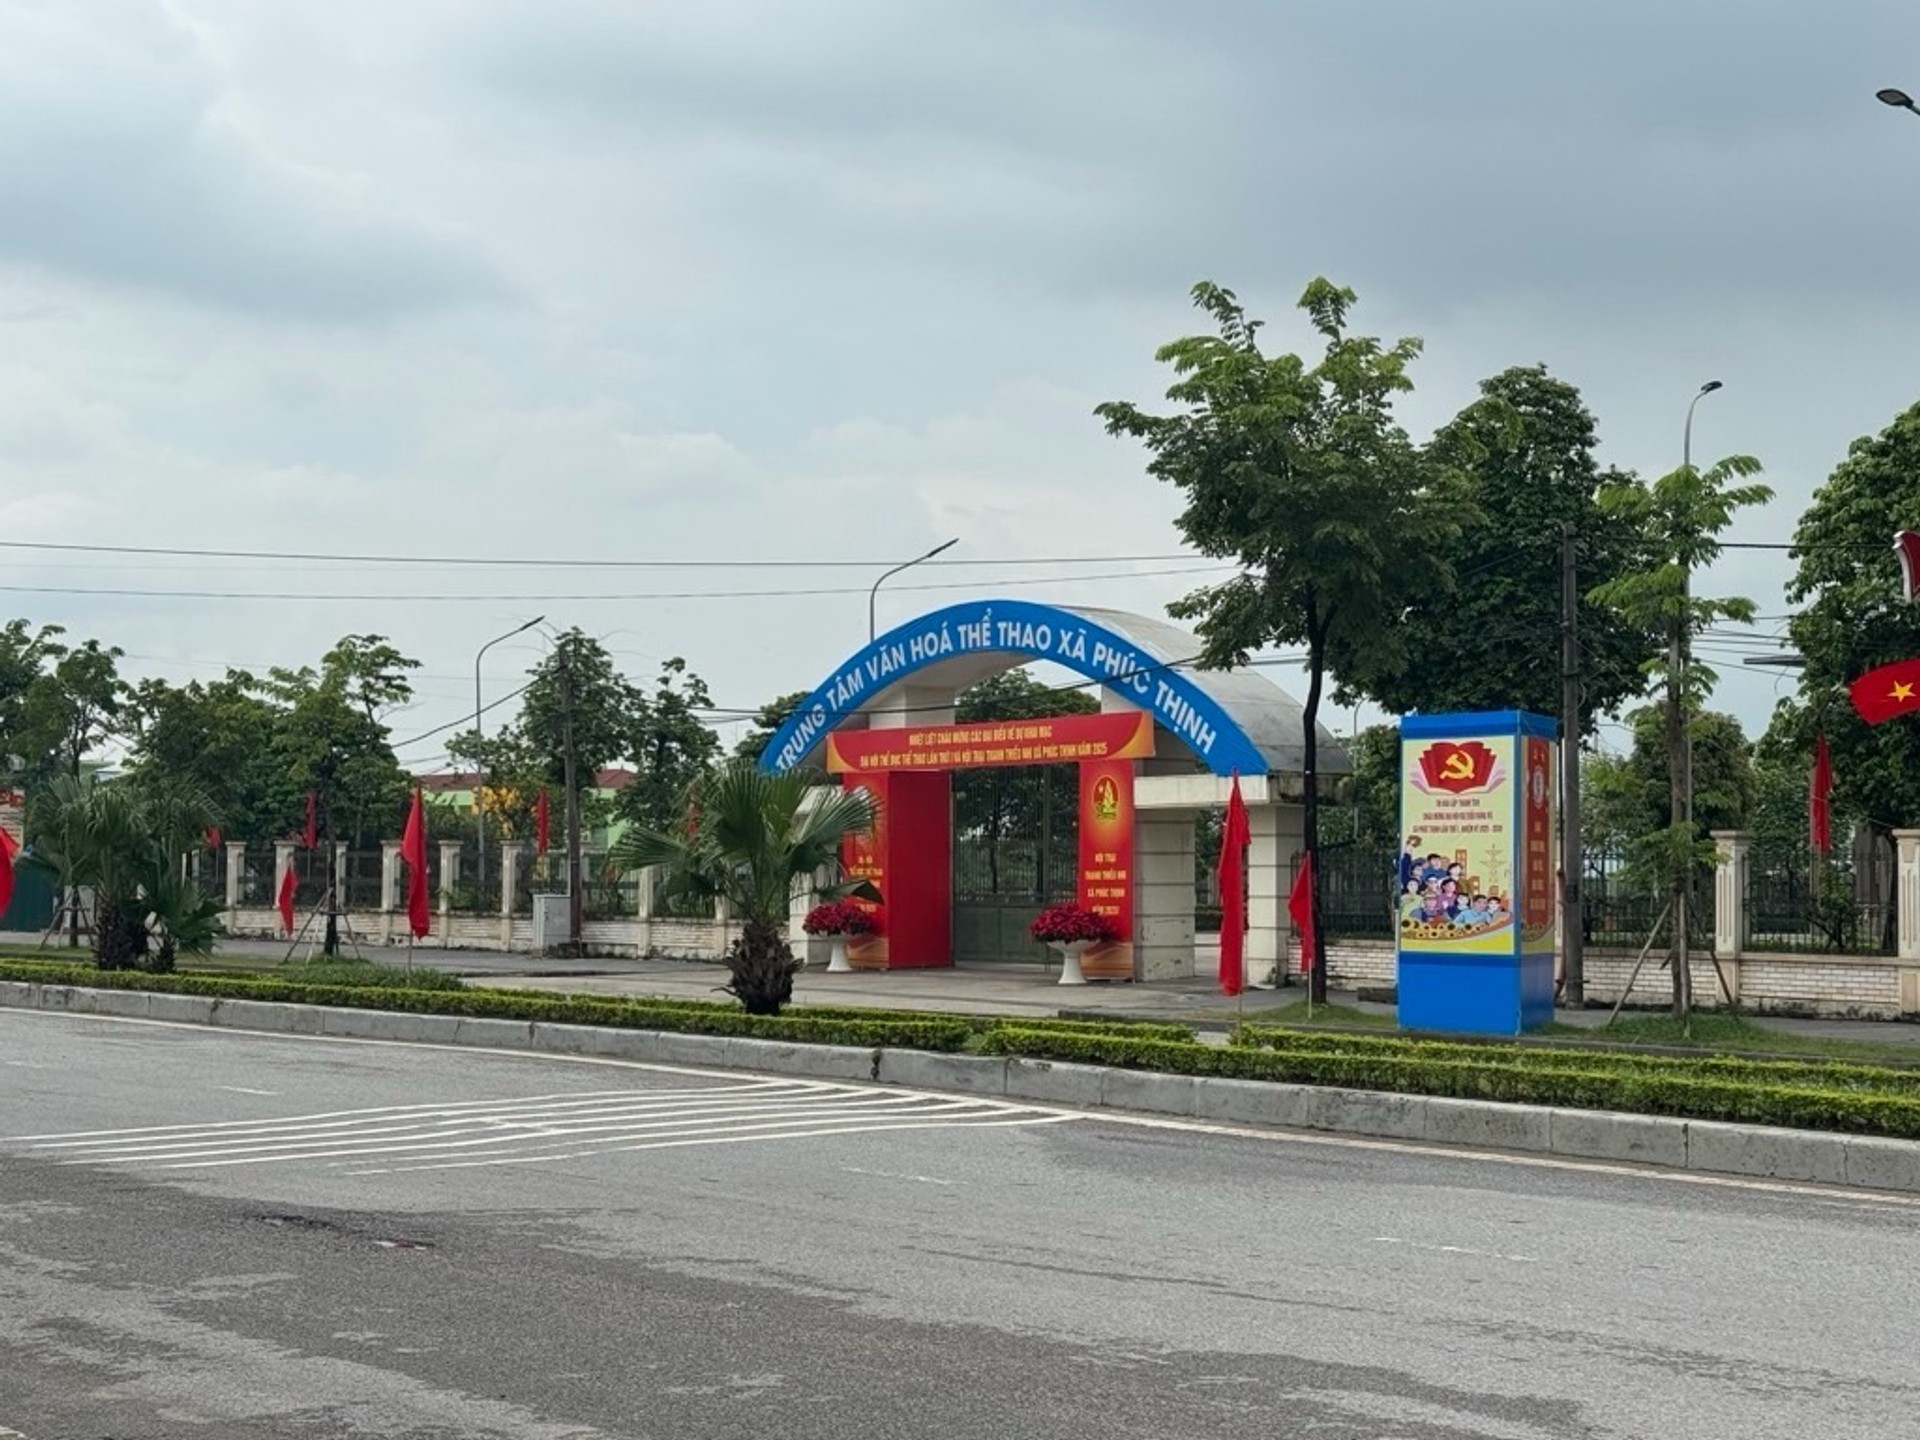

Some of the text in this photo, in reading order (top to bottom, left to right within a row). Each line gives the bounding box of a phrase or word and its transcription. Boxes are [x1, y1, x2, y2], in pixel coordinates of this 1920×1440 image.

[776, 607, 1217, 771] TRUNG TÂM VĂN HOÁ THỂ THAO XÃ PHÚC THỊNH
